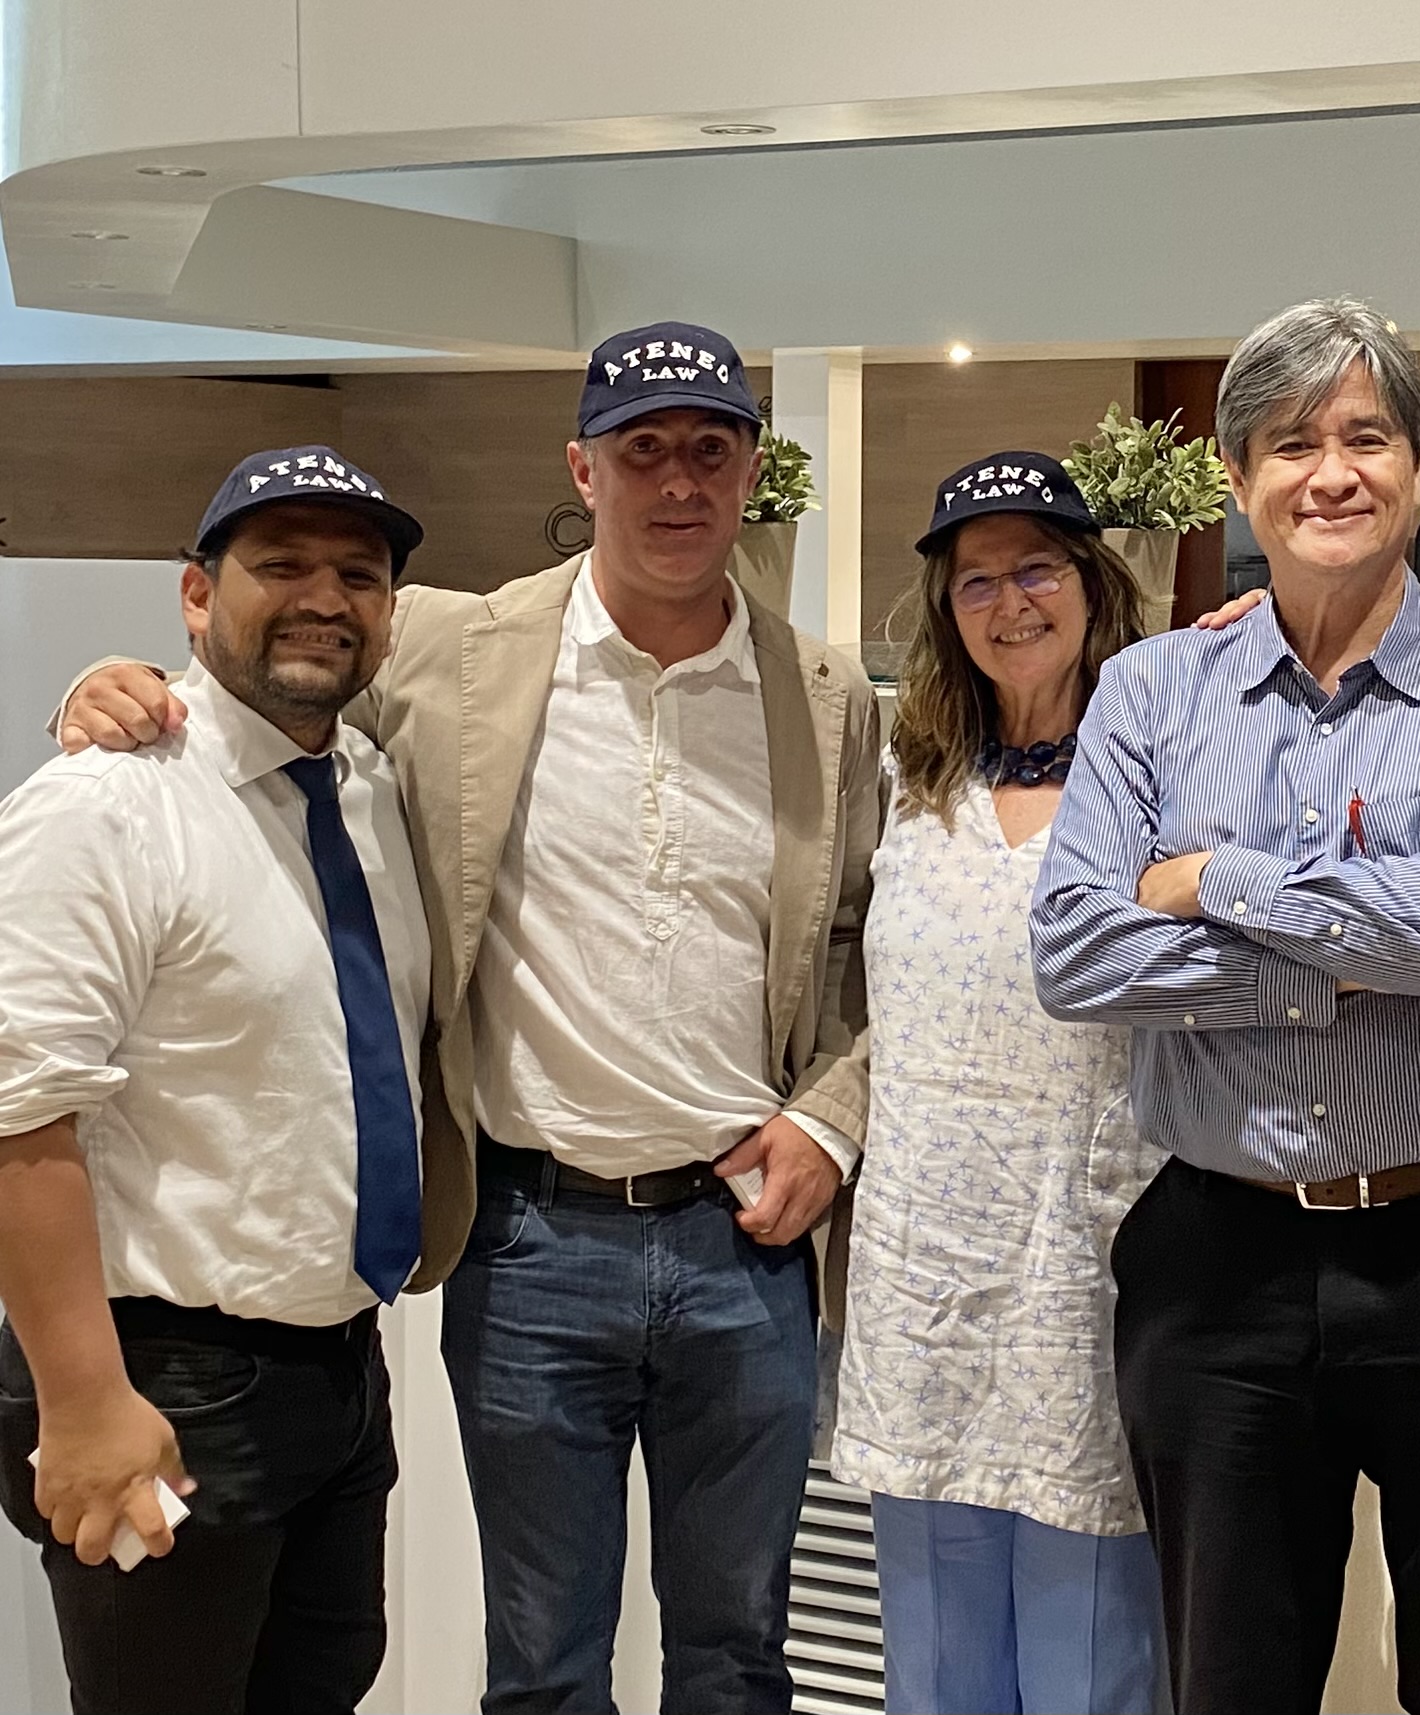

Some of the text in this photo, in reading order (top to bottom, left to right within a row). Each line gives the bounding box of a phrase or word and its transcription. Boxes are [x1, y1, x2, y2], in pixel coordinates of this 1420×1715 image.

[604, 341, 729, 386] ATENEO
[642, 366, 699, 381] LAW
[293, 475, 354, 492] LAW
[972, 483, 1025, 500] LAW
